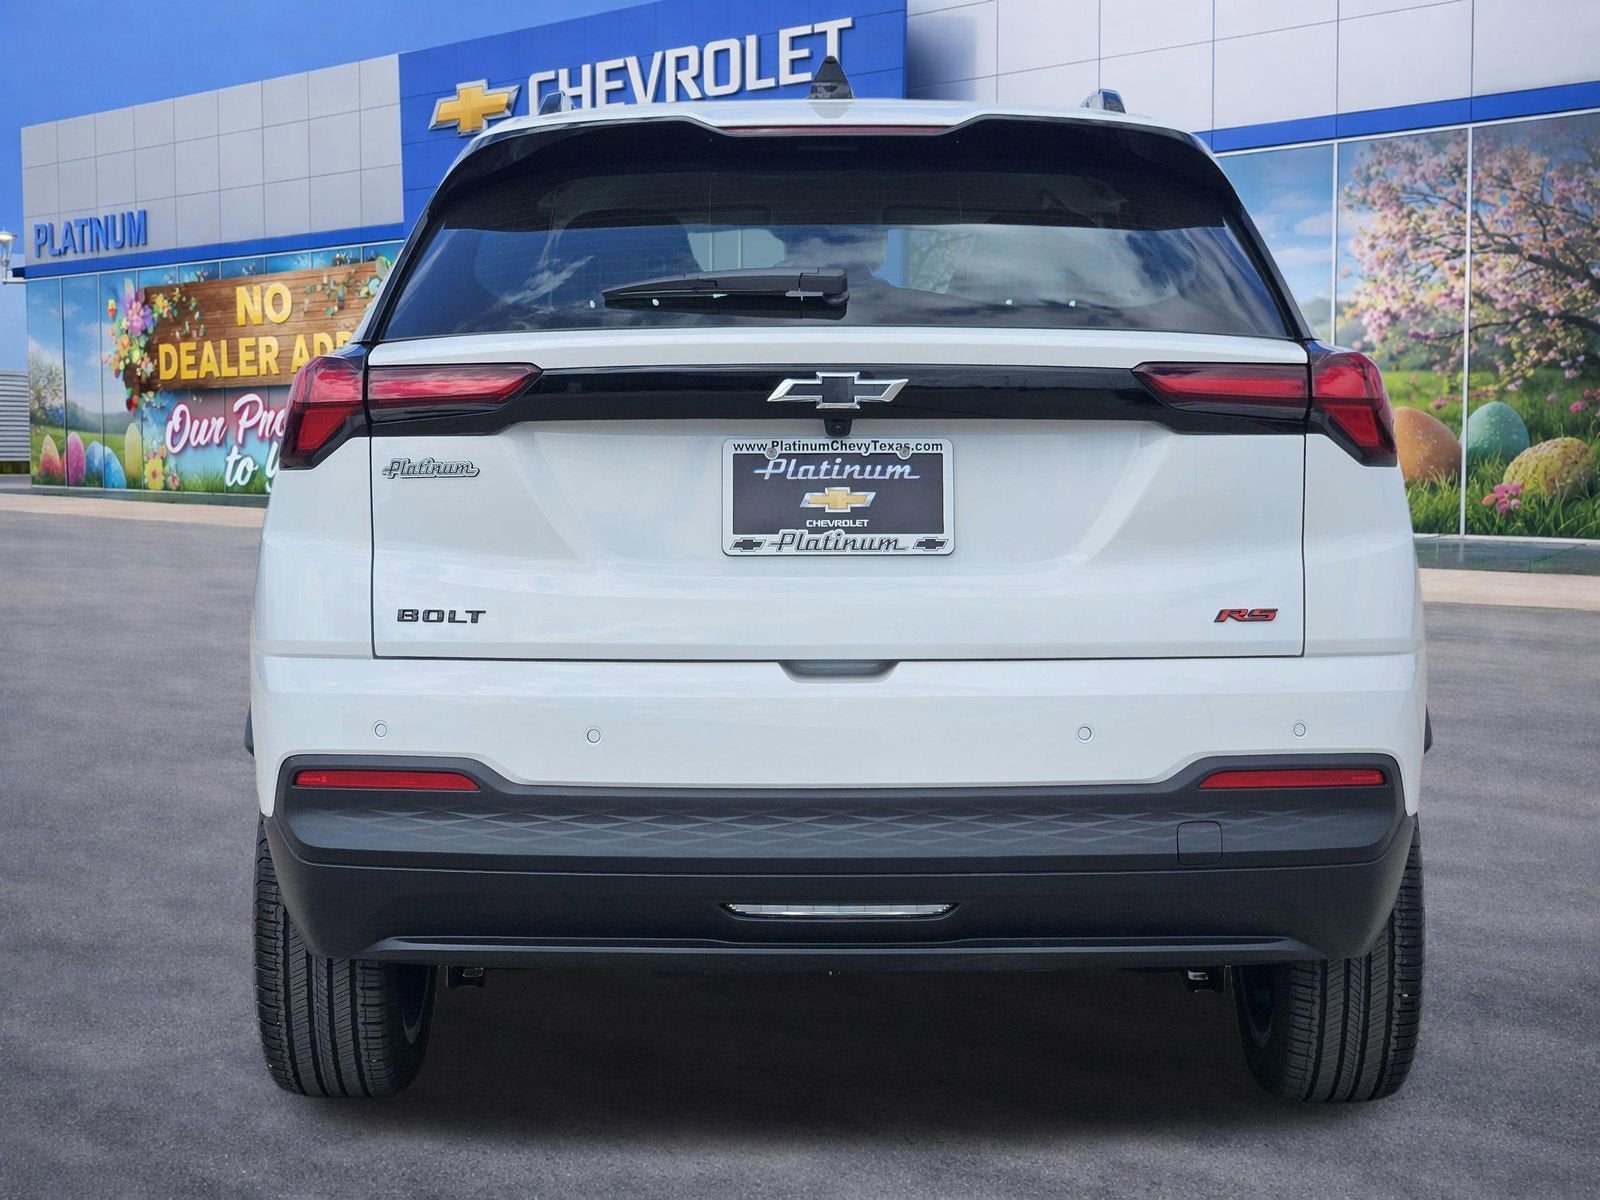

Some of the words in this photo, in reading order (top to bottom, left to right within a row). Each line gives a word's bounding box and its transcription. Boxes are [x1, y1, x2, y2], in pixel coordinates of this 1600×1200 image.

[527, 17, 854, 116] CHEVROLET
[34, 209, 148, 258] PLATINUM
[235, 281, 293, 327] NO
[158, 335, 280, 381] DEALER
[165, 404, 228, 454] Our
[733, 440, 943, 453] wwwPlatinumChevyTexas.com
[225, 445, 258, 486] to
[382, 457, 480, 479] Platinum
[753, 457, 921, 480] Platinum
[806, 519, 869, 528] CHEVROLET
[768, 530, 909, 552] Platinum
[397, 608, 487, 624] BOLT
[1213, 608, 1279, 623] RS
